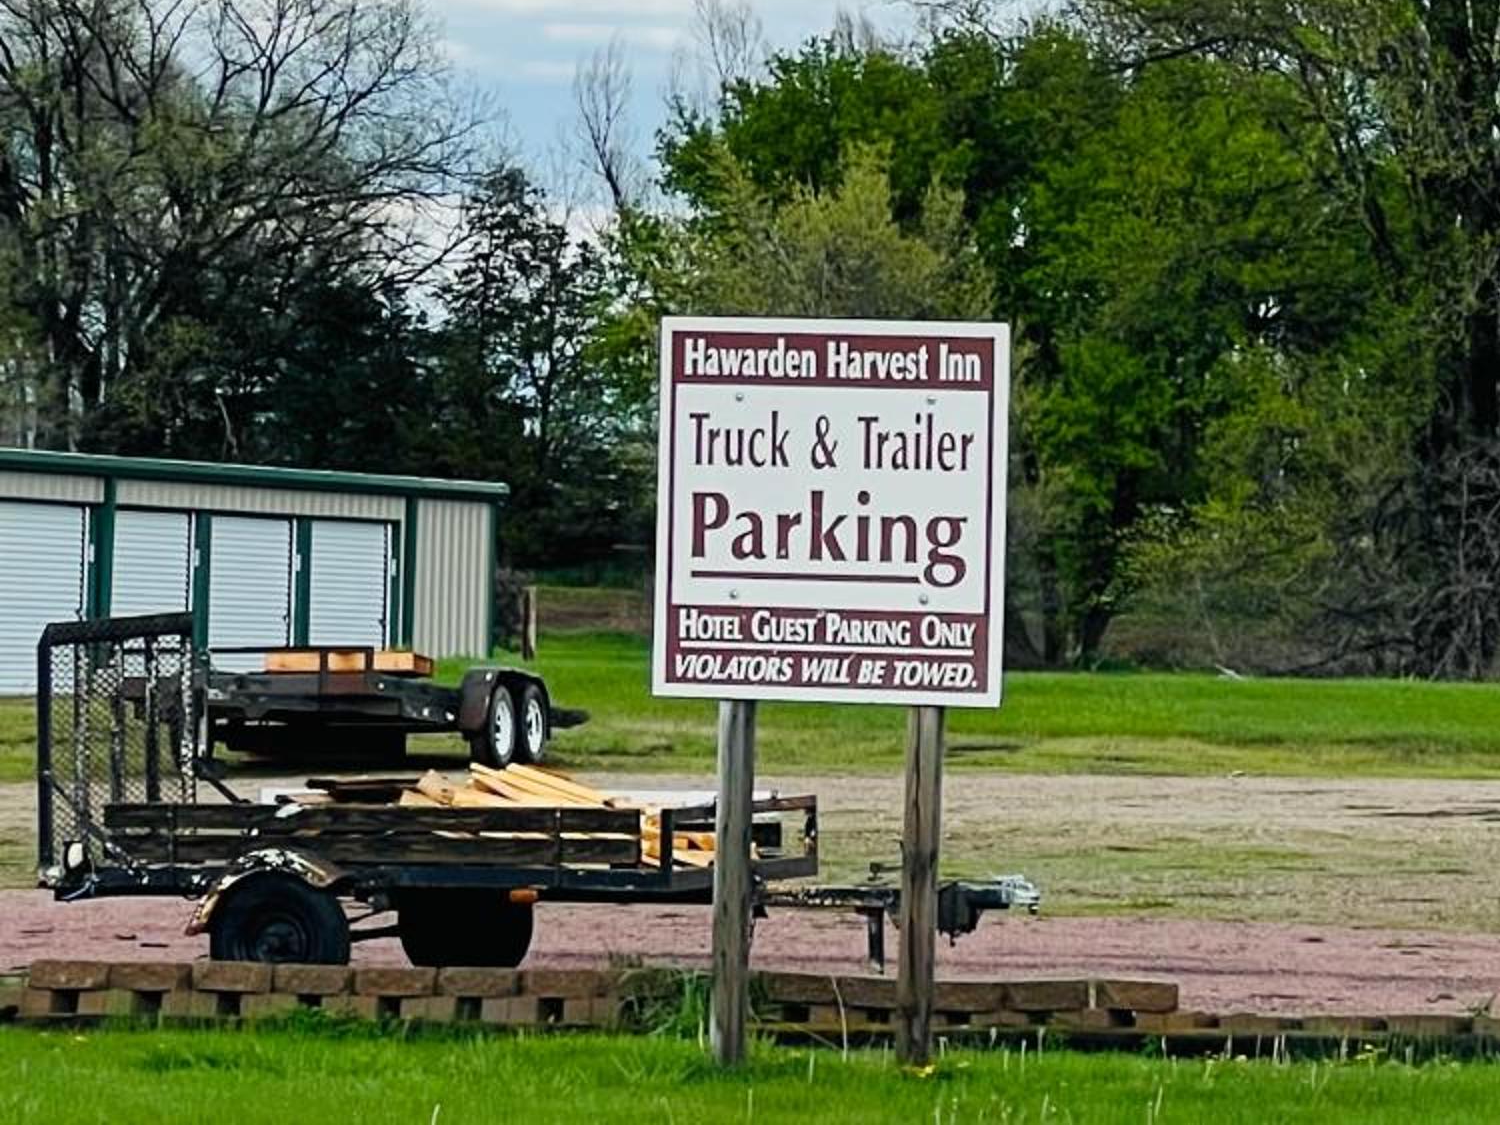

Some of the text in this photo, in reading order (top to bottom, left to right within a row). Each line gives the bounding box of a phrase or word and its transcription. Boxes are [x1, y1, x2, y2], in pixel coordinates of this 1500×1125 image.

[684, 338, 981, 382] Hawarden Harvest Inn
[689, 410, 975, 472] Truck & Trailer
[691, 490, 968, 588] Parking
[674, 654, 979, 688] VIOLATORS WILL BE TOWED.
